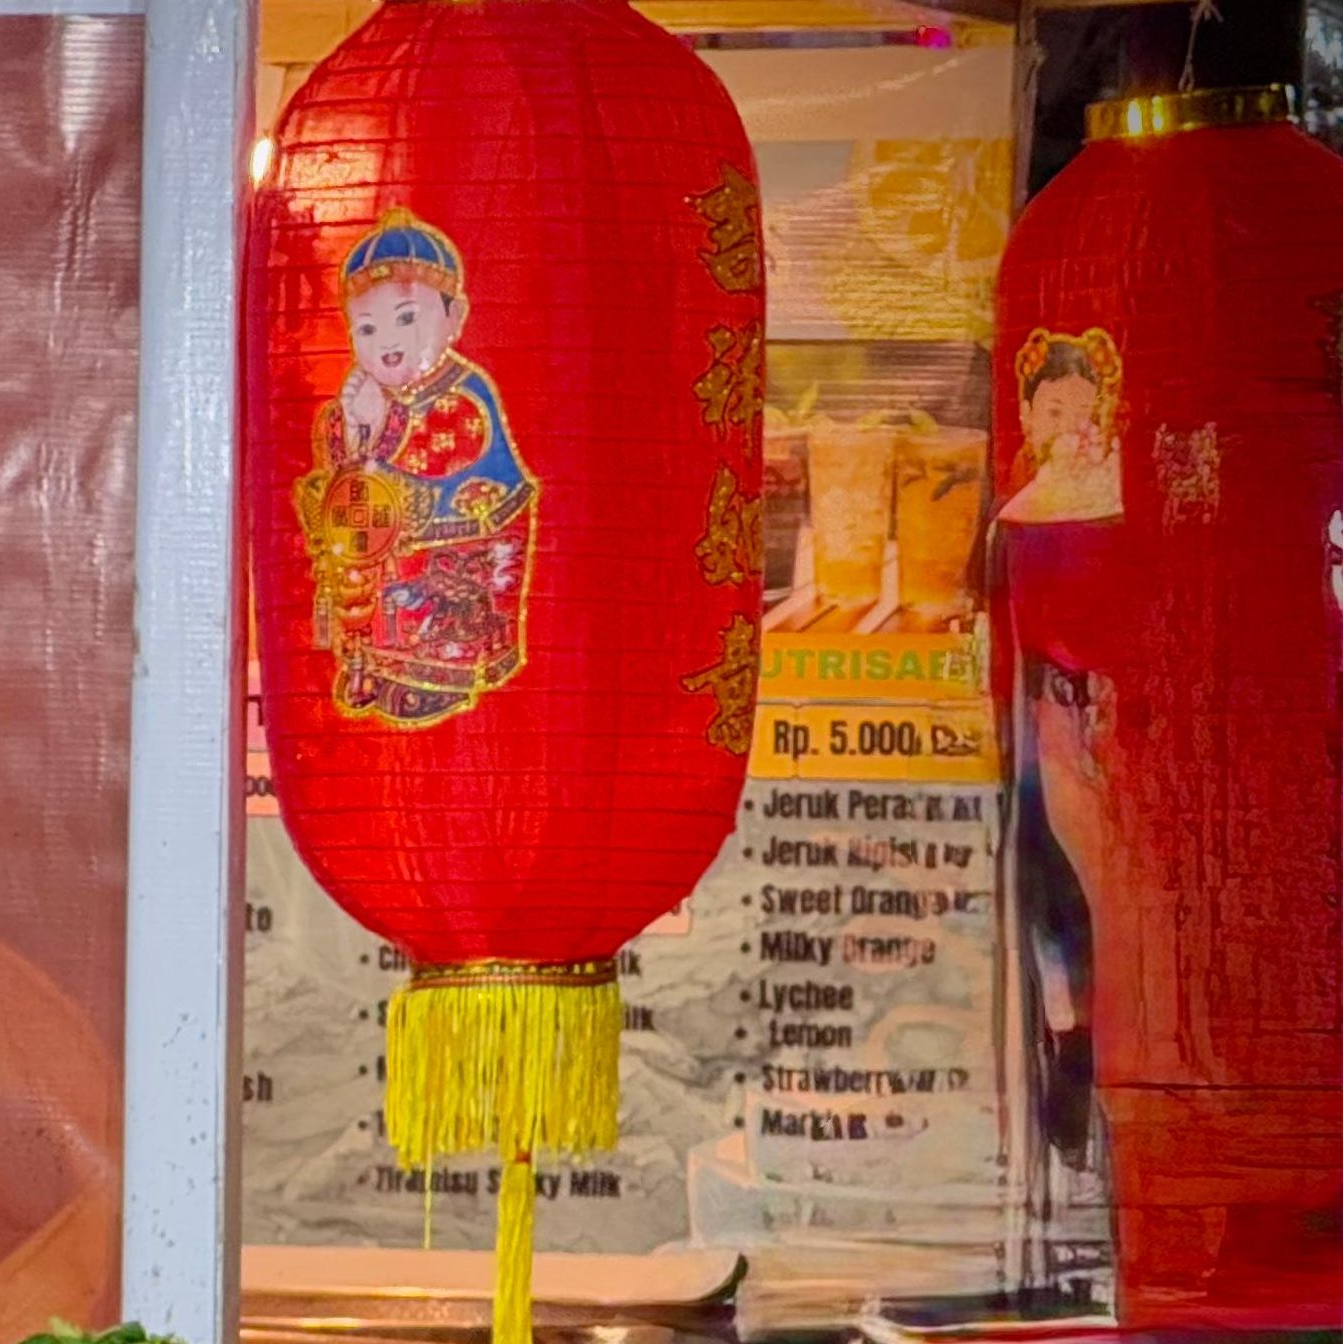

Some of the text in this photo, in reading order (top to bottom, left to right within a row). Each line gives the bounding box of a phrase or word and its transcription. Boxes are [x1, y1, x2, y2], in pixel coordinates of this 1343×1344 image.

[773, 719, 819, 762] Rp.
[762, 789, 840, 821] Jeruk
[762, 836, 839, 868] Jeruk
[761, 885, 842, 916] Sweet
[760, 930, 834, 967] Milky
[758, 979, 855, 1014] Lychee
[768, 1018, 853, 1049] Lemon
[569, 1170, 621, 1198] Milk
